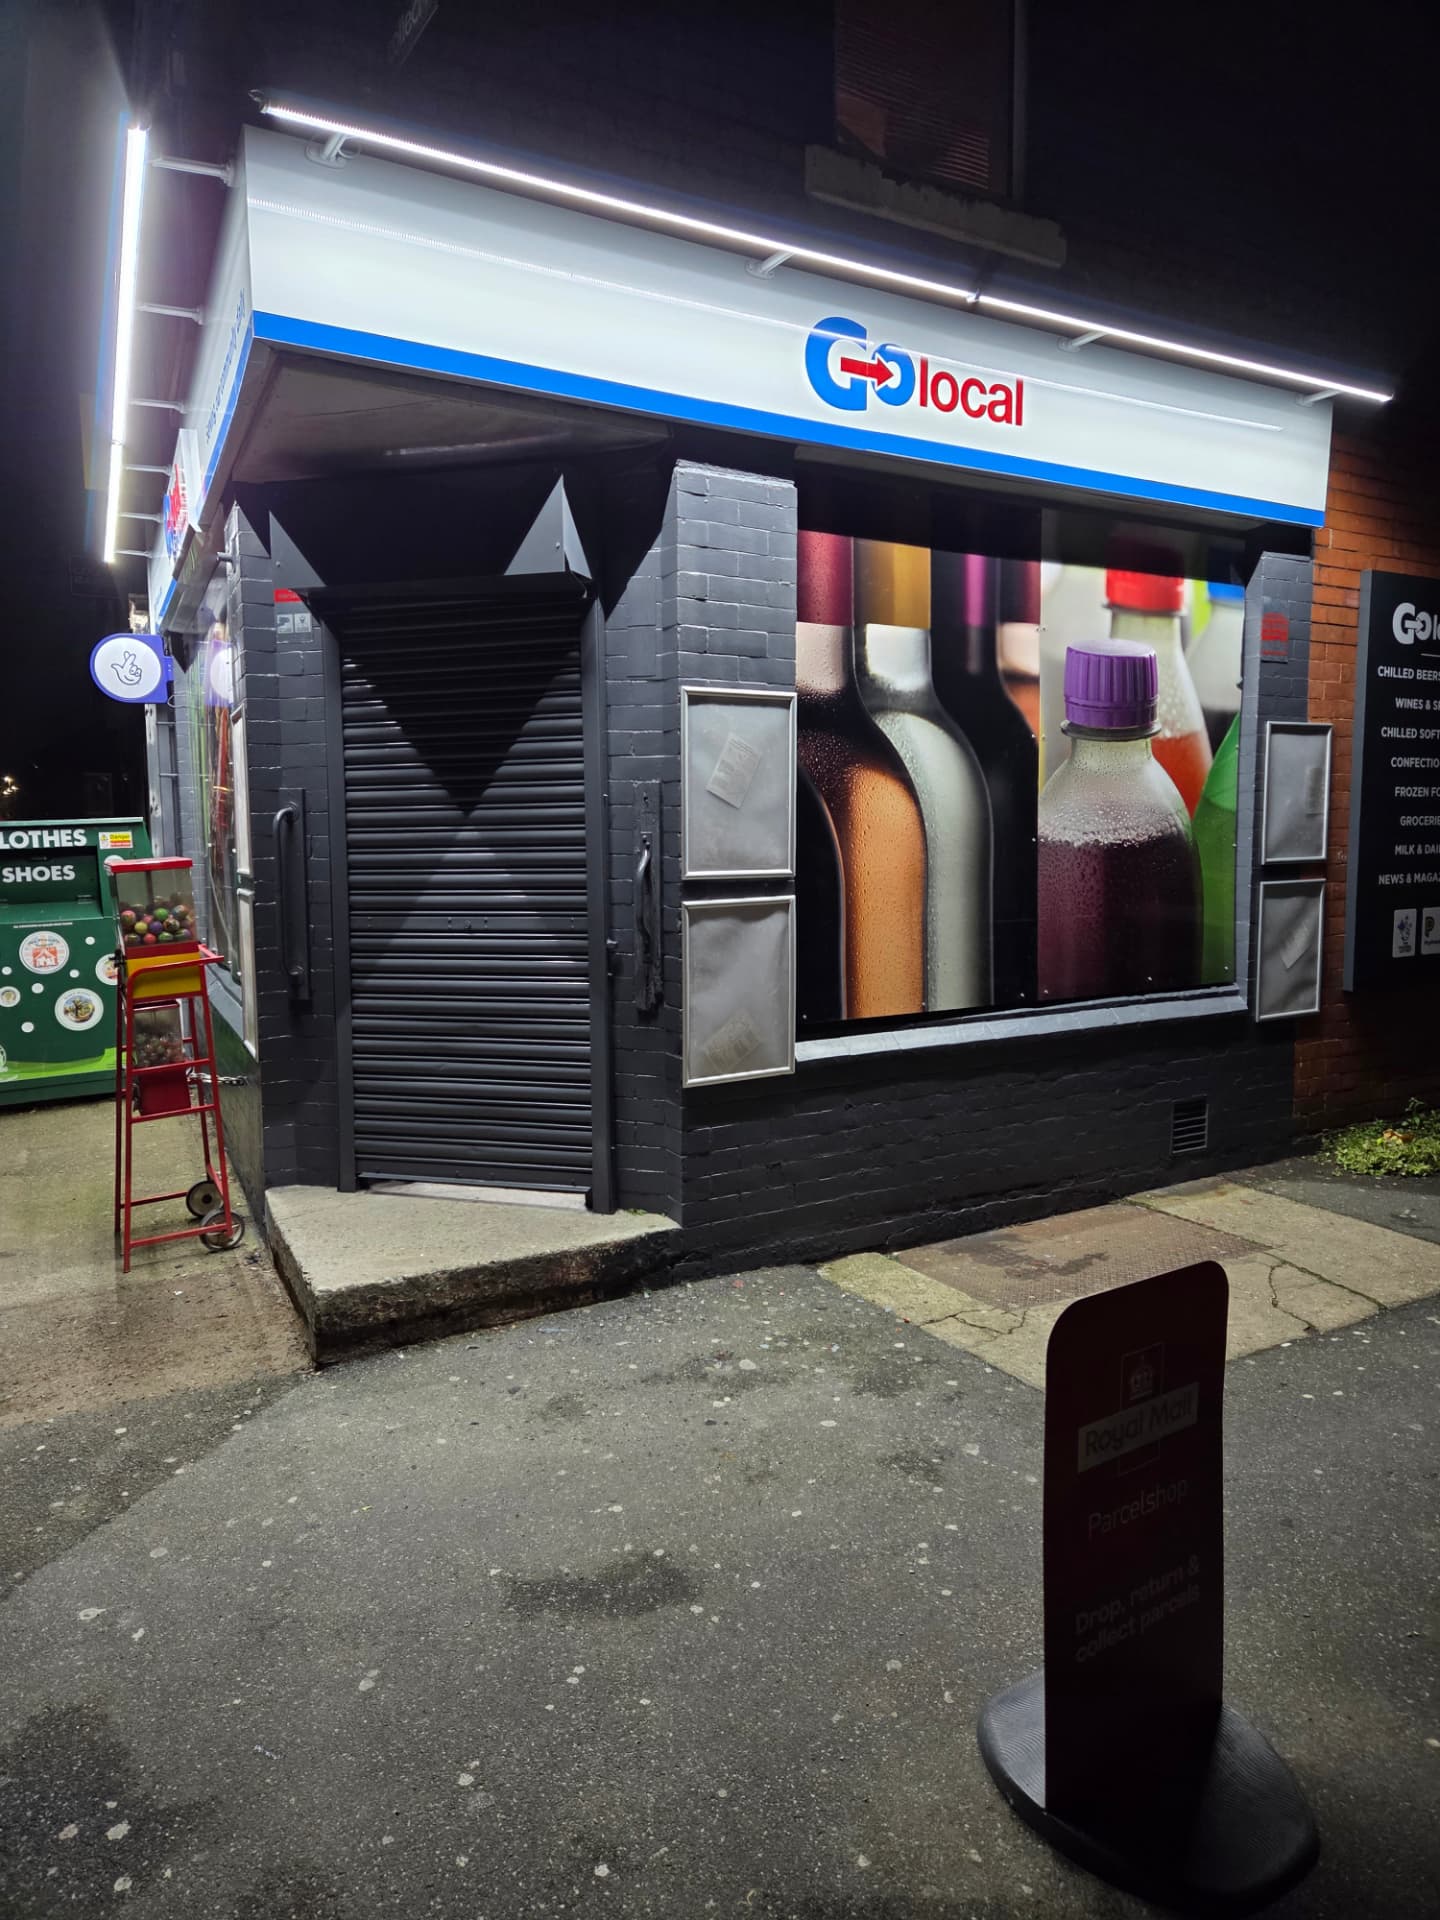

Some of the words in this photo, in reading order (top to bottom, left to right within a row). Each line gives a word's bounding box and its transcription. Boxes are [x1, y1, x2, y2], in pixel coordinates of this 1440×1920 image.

[1377, 665, 1415, 679] CHILLED
[1395, 697, 1424, 710] WINES
[1381, 726, 1418, 739] CHILLED
[1395, 786, 1430, 798] FROZEN
[1394, 844, 1415, 856] MILK
[2, 865, 76, 883] SHOES
[1378, 873, 1405, 885] NEWS
[1085, 1409, 1144, 1457] Royal
[1149, 1390, 1193, 1432] Mail
[1088, 1480, 1189, 1542] Parcelshop
[1075, 1598, 1126, 1635] Drop,
[1130, 1566, 1184, 1607] return
[1187, 1554, 1200, 1577] &
[1075, 1615, 1136, 1662] collect
[1140, 1583, 1200, 1635] parcels
